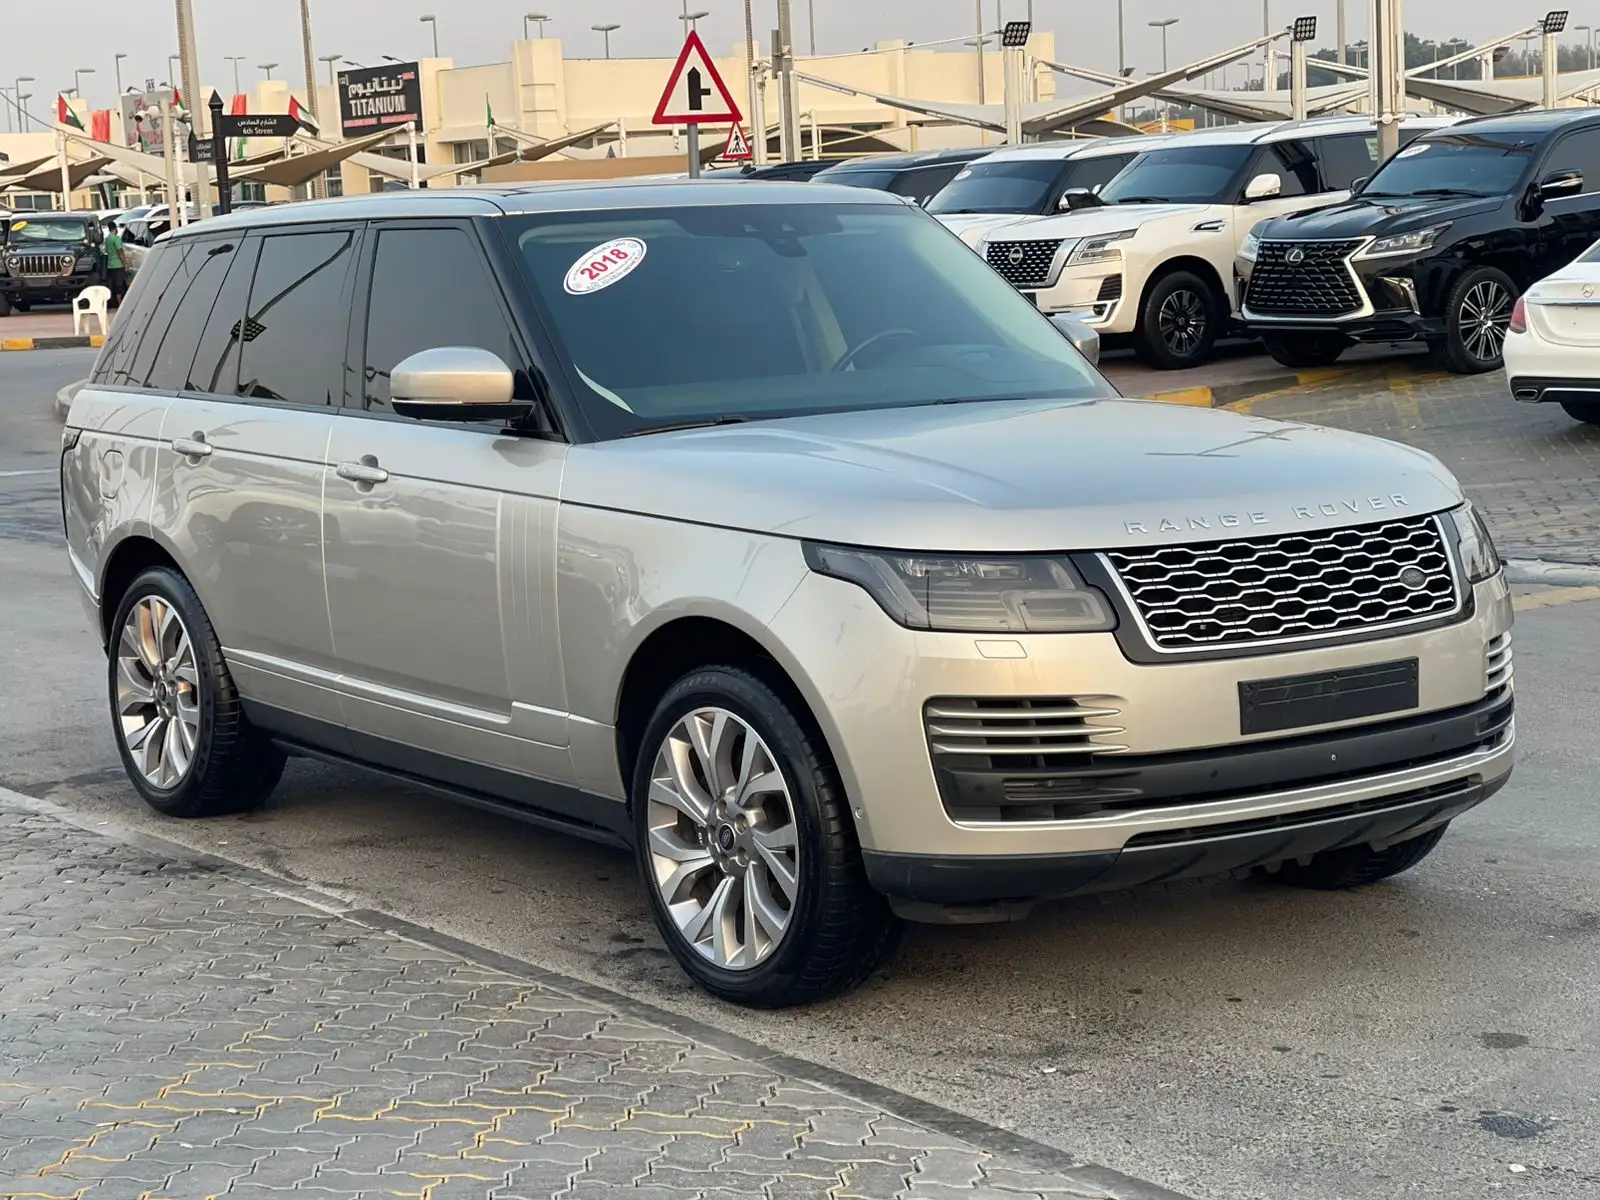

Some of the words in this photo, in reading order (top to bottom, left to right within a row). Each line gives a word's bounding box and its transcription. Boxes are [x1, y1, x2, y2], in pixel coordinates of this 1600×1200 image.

[350, 94, 407, 116] TITANIUM
[579, 248, 629, 281] 2018
[1123, 511, 1269, 535] RANGE
[1290, 492, 1410, 520] ROVER
